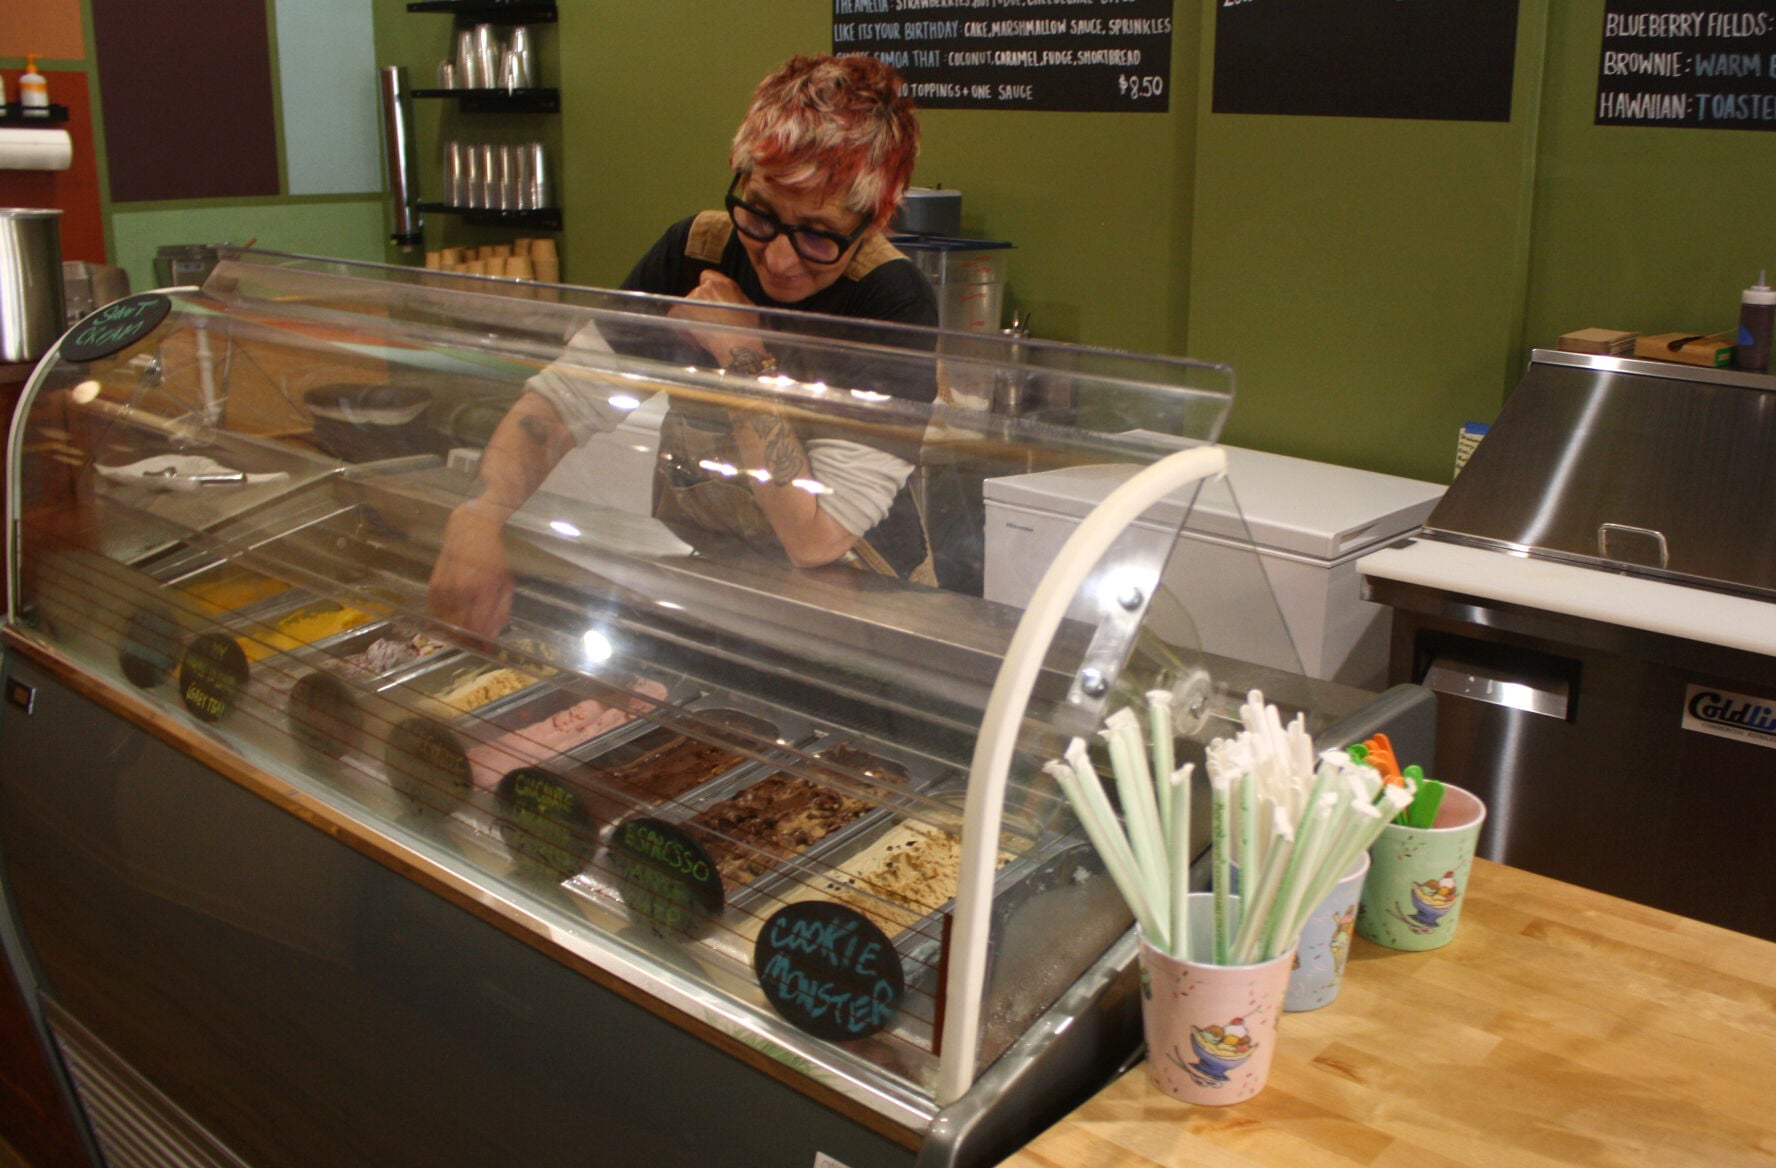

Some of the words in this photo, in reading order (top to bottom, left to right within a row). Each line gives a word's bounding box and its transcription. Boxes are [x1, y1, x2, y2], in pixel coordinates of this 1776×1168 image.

[834, 23, 855, 42] LIKE
[874, 22, 901, 41] YOUR
[1108, 17, 1172, 36] SPRINKLES
[1606, 12, 1705, 37] BLUEBERRY
[1695, 53, 1762, 77] WARM
[997, 84, 1033, 101] SAUCE
[1117, 73, 1164, 100] $8.50
[1695, 93, 1776, 121] TOASTE
[75, 320, 145, 346] CREAM
[623, 822, 710, 882] ESPRESSO
[770, 917, 882, 977] COOKIE
[761, 953, 895, 1033] MONSTER
